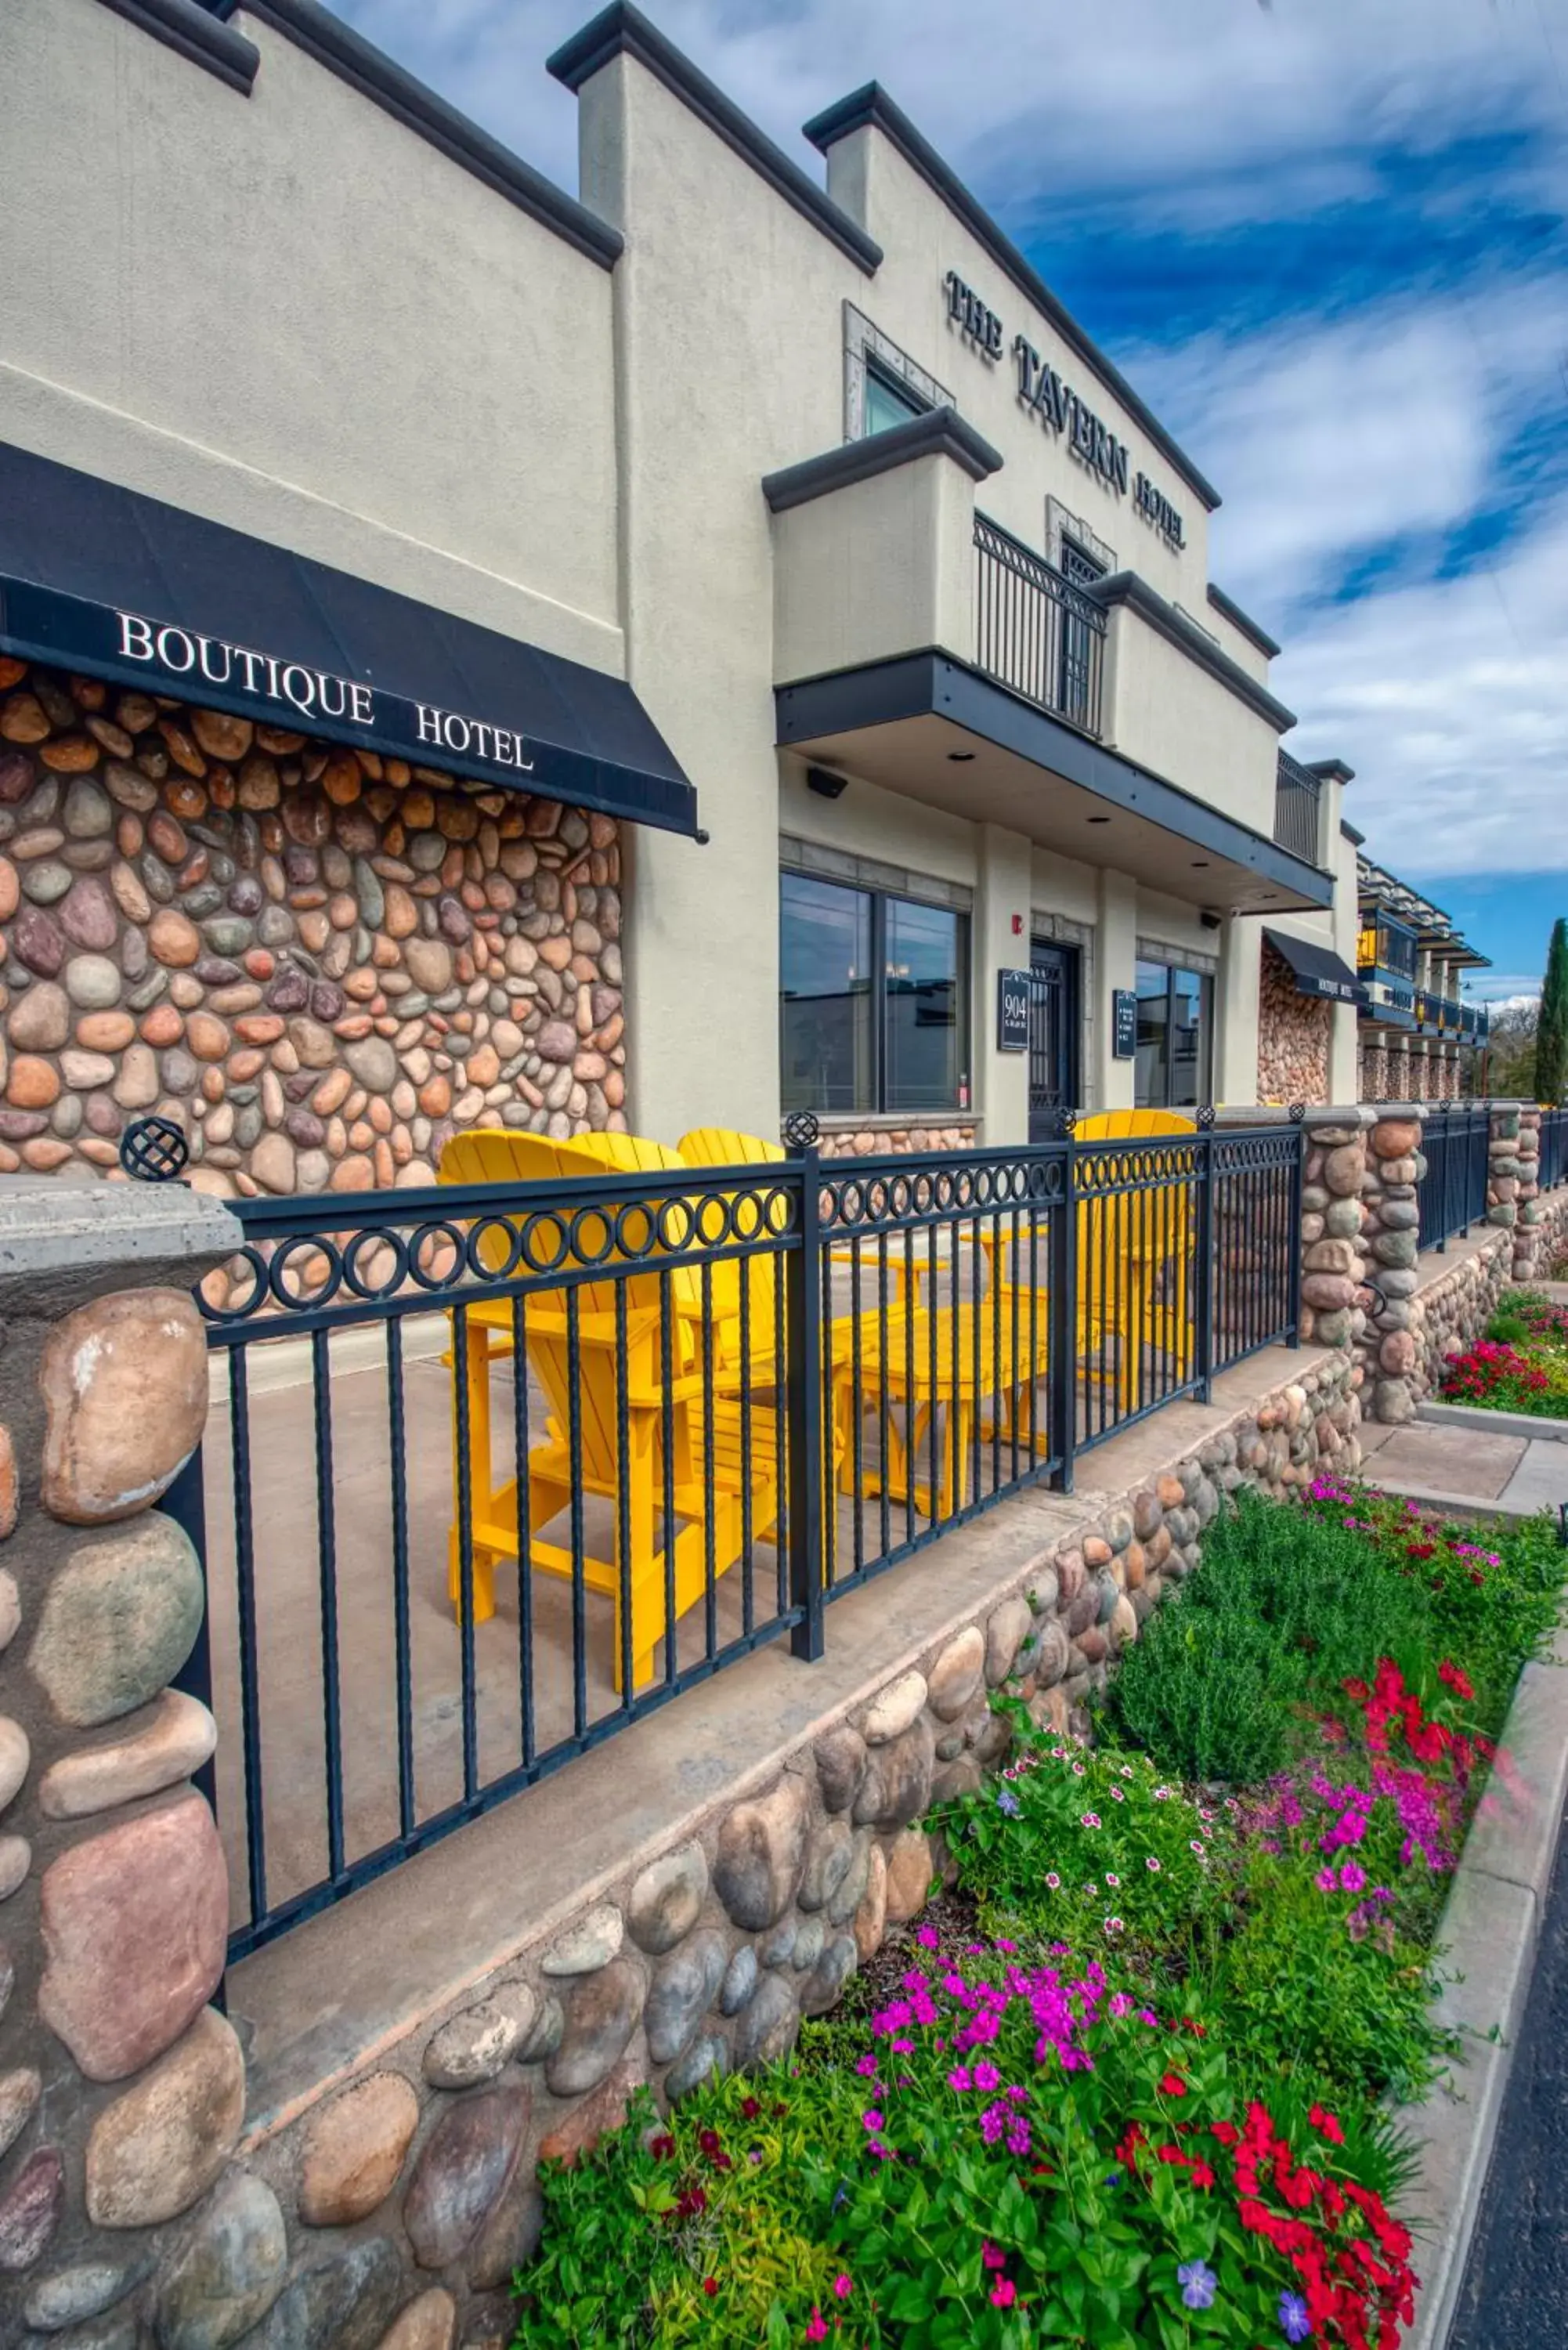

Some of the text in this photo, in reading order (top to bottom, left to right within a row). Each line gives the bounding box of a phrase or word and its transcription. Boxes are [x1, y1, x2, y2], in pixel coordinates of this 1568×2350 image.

[945, 270, 1186, 550] THE TAVERN HOTEL
[116, 612, 533, 771] BOUTIQUE HOTEL
[1005, 994, 1026, 1019] 904
